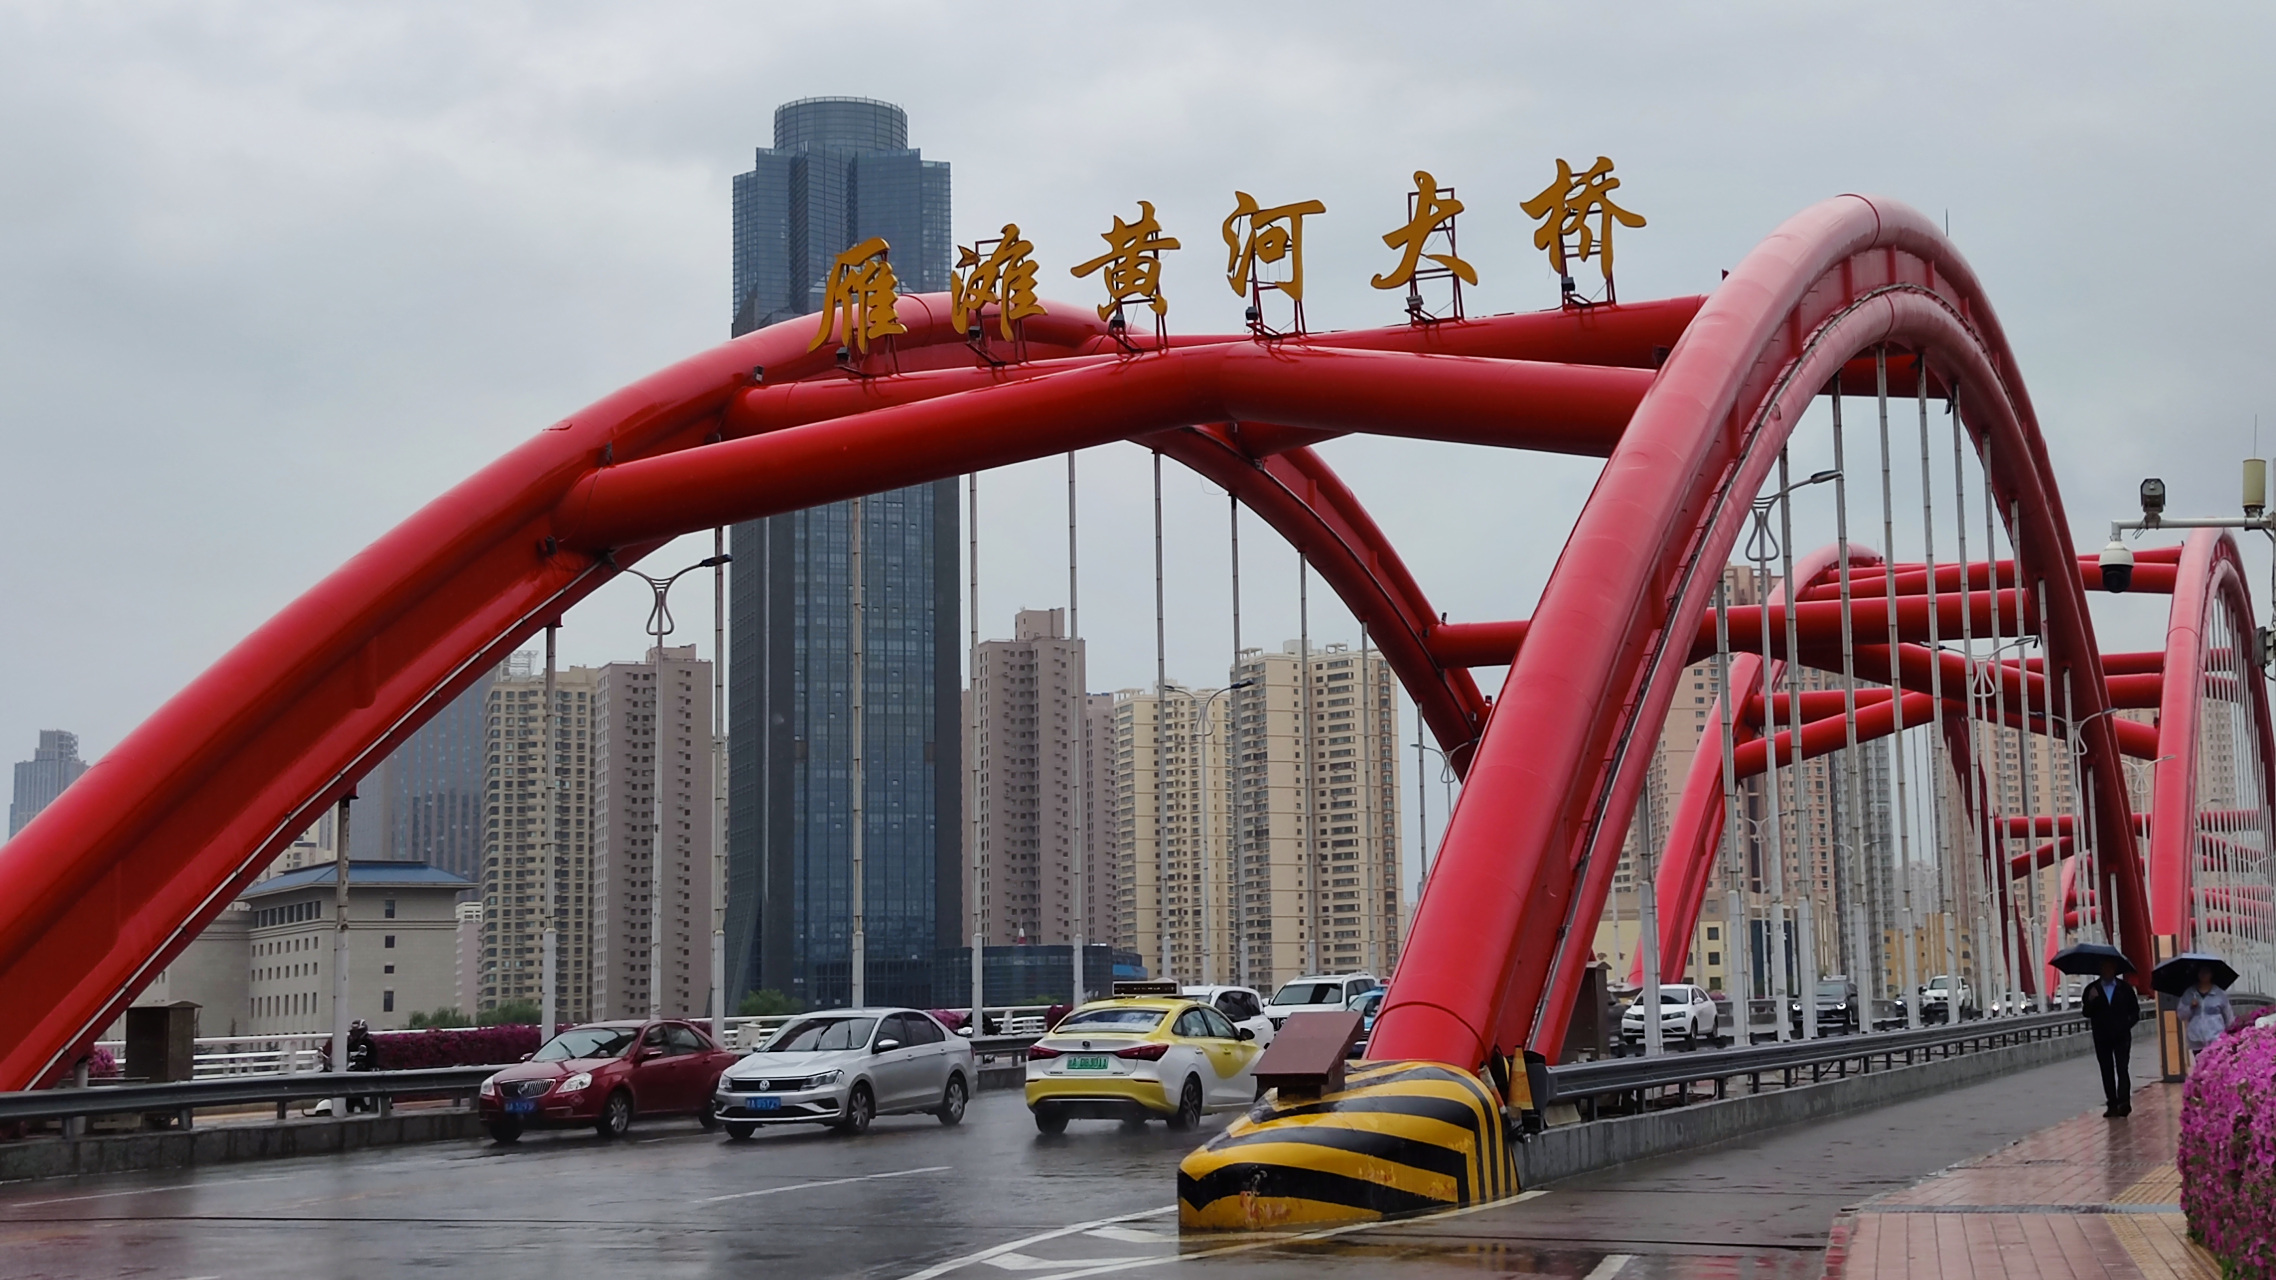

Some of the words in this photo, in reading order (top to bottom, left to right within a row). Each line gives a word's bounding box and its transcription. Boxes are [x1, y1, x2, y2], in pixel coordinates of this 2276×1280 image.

[807, 156, 1647, 354] 雁滩黄河大桥
